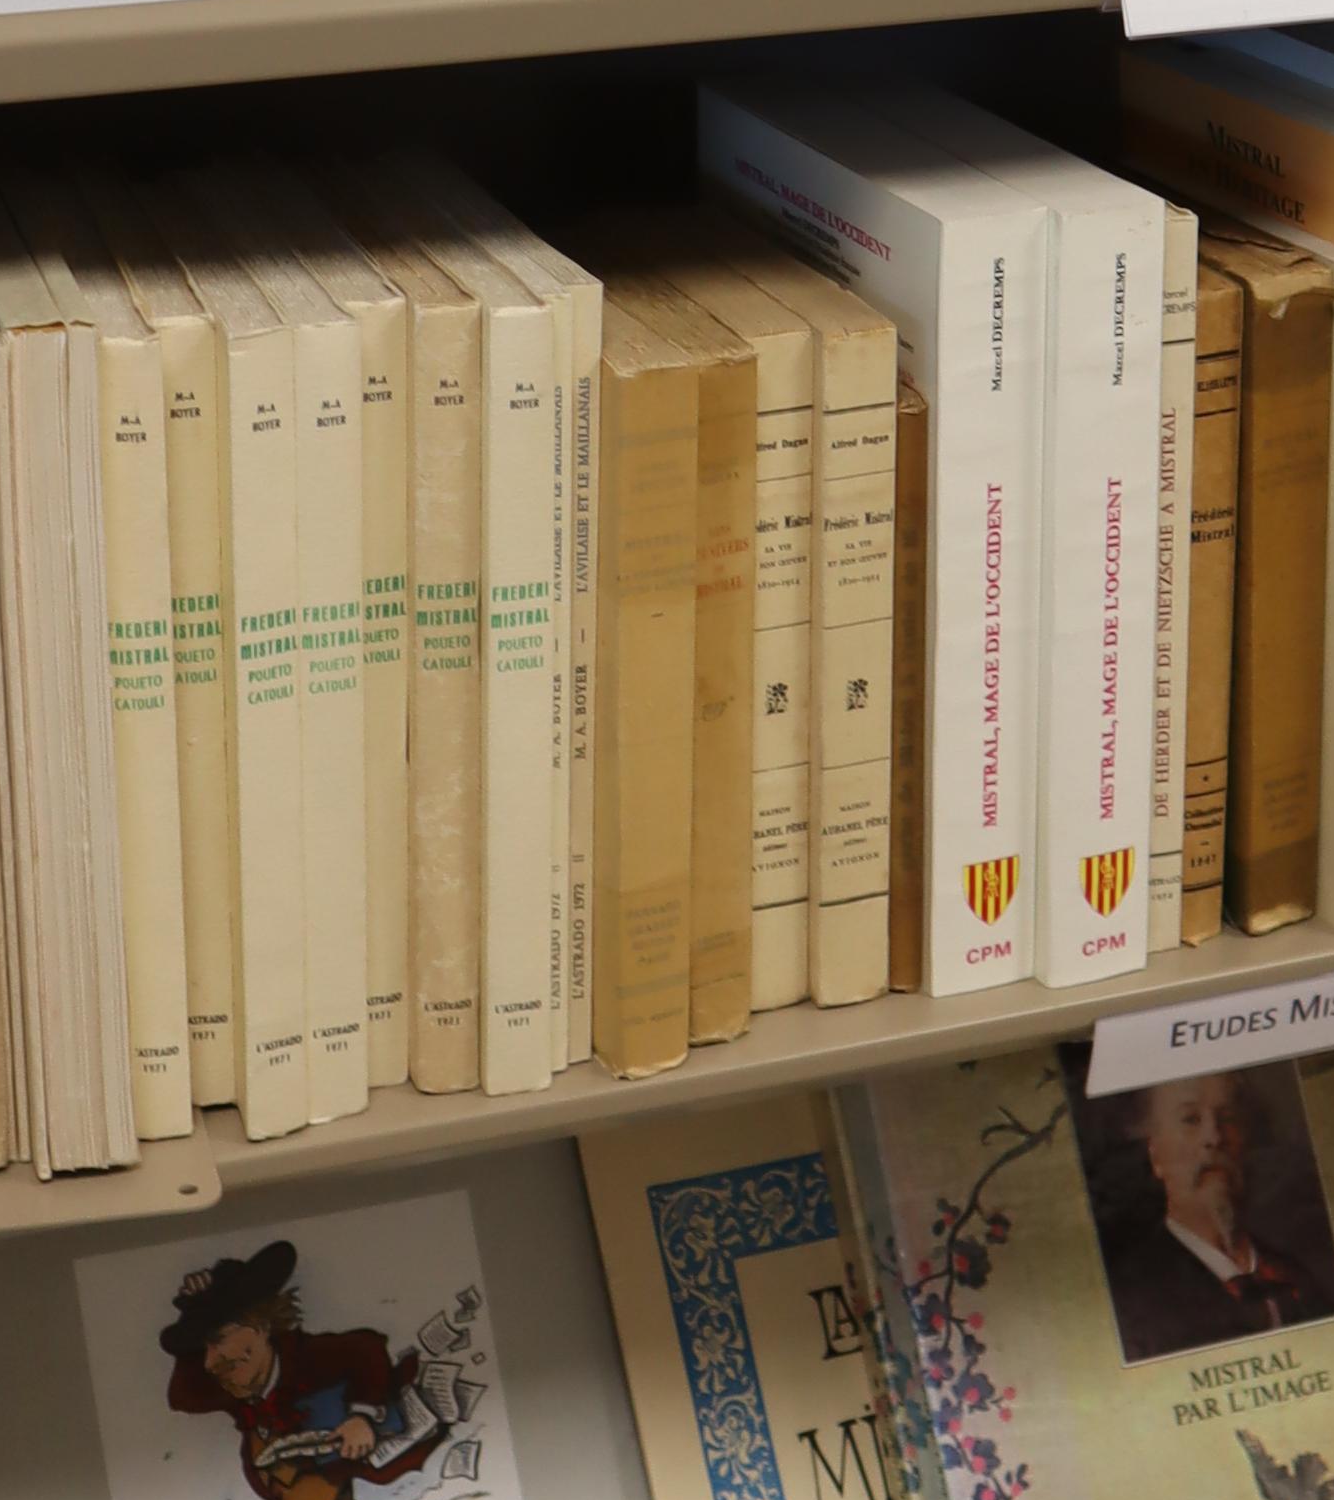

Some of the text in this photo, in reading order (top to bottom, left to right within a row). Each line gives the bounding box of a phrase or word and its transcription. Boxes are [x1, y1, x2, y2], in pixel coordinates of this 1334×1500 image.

[991, 256, 1007, 393] Marcel DECREMPS
[252, 418, 281, 432] BOYER
[241, 608, 297, 633] FREDERI
[240, 635, 298, 661] MISTRAL
[983, 483, 1004, 829] MISTRAL, MAGE DE L'OCCIDENT
[965, 941, 1012, 966] CPM
[1186, 1346, 1303, 1395] MISTRAL
[1170, 1366, 1334, 1430] PAR L'IMAGE
